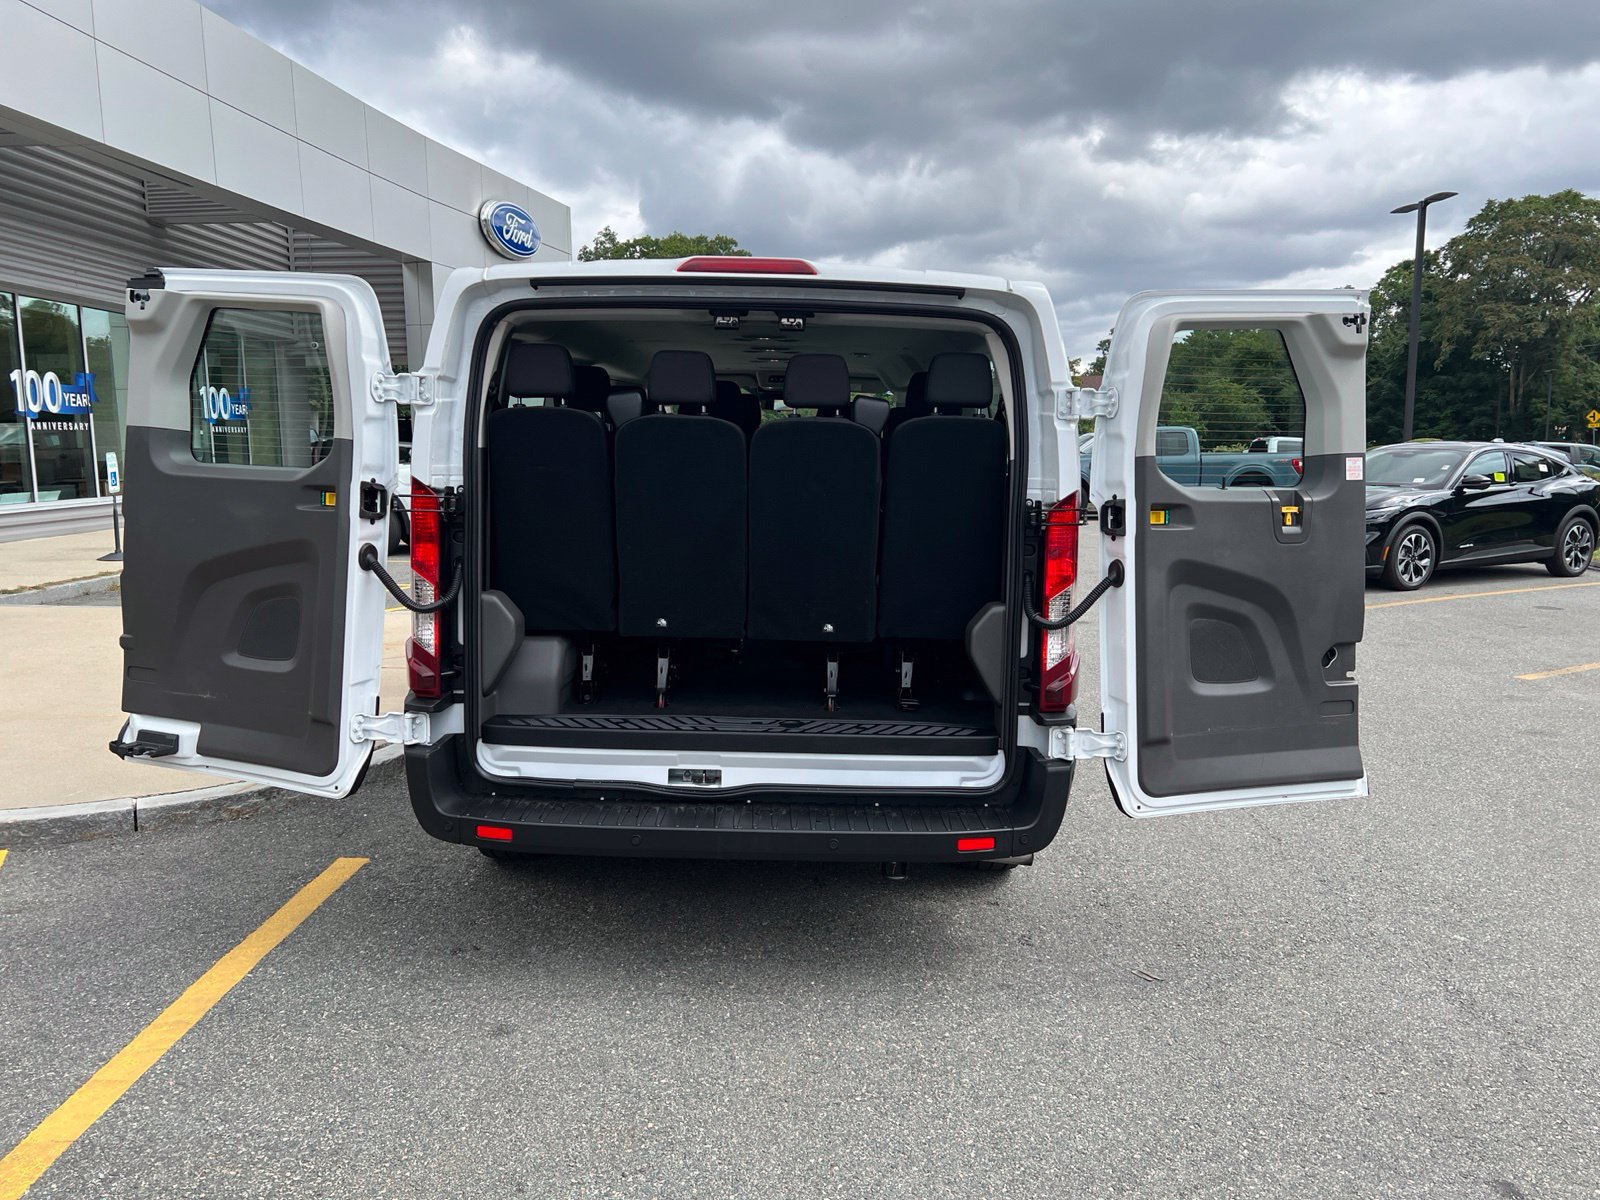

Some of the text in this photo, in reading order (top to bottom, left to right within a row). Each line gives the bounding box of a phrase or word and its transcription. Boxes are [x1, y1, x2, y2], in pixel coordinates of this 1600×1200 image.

[503, 212, 533, 249] Ford
[10, 368, 62, 413] 100
[199, 385, 231, 420] 100
[30, 421, 89, 431] ANNIVERSARY
